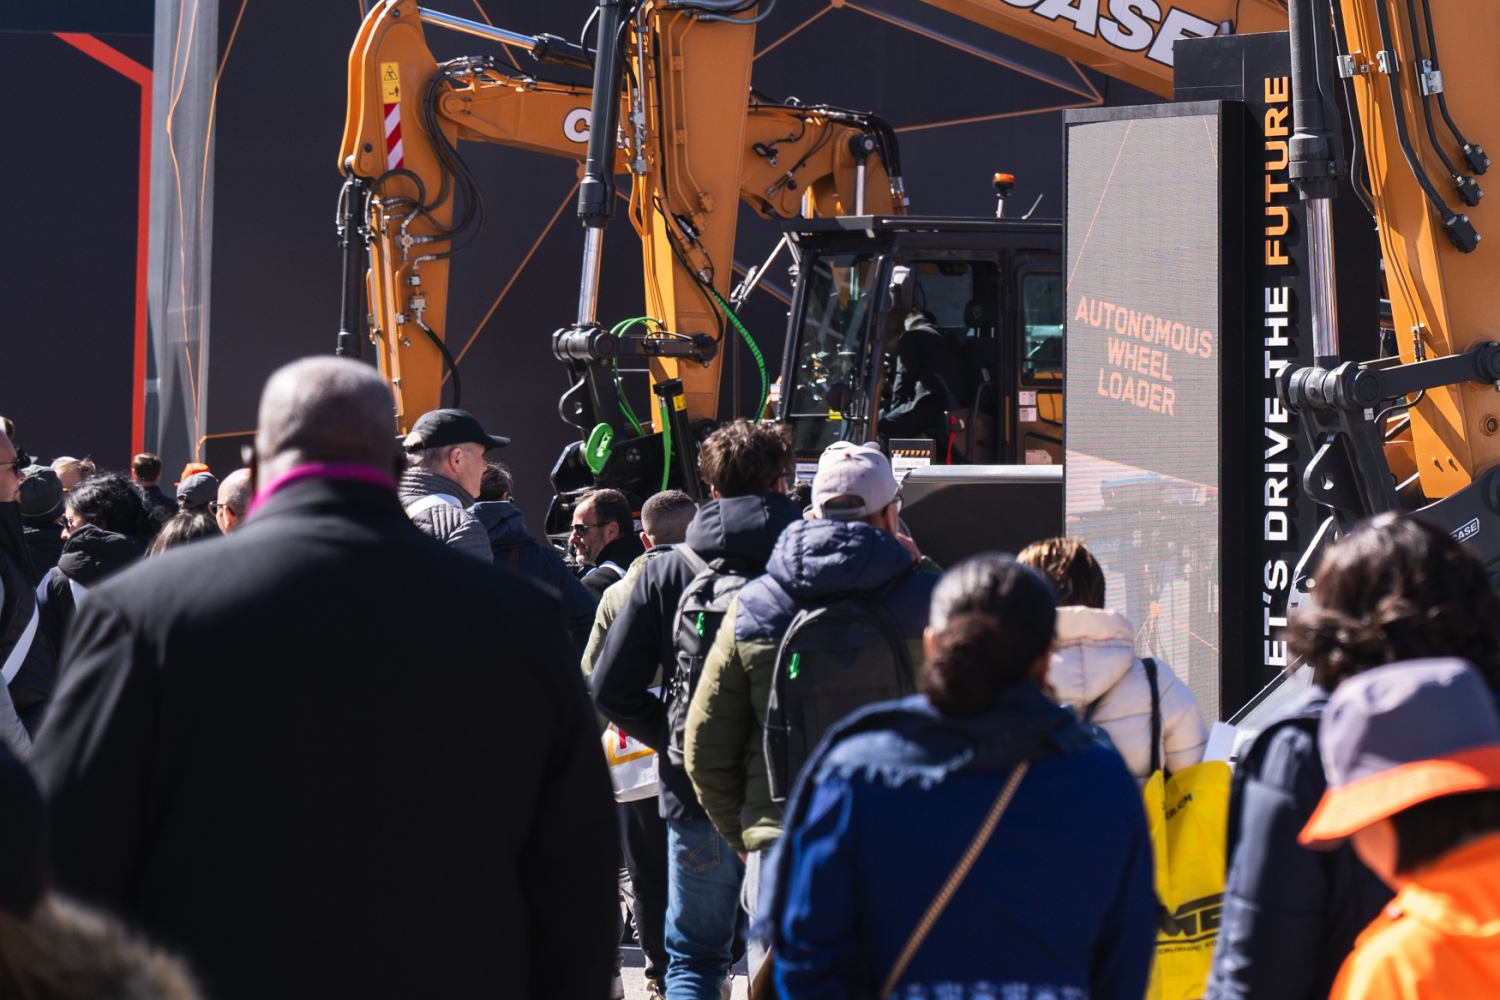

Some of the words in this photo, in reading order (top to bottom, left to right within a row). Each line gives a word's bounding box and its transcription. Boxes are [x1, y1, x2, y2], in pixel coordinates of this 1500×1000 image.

[1264, 76, 1289, 266] FUTURE
[1074, 295, 1213, 359] AUTONOMOUS
[1107, 336, 1173, 382] WHEEL
[1264, 286, 1289, 379] THE
[1097, 367, 1176, 417] LOADER
[1264, 397, 1289, 541] DRIVE
[1263, 559, 1289, 667] ET'S
